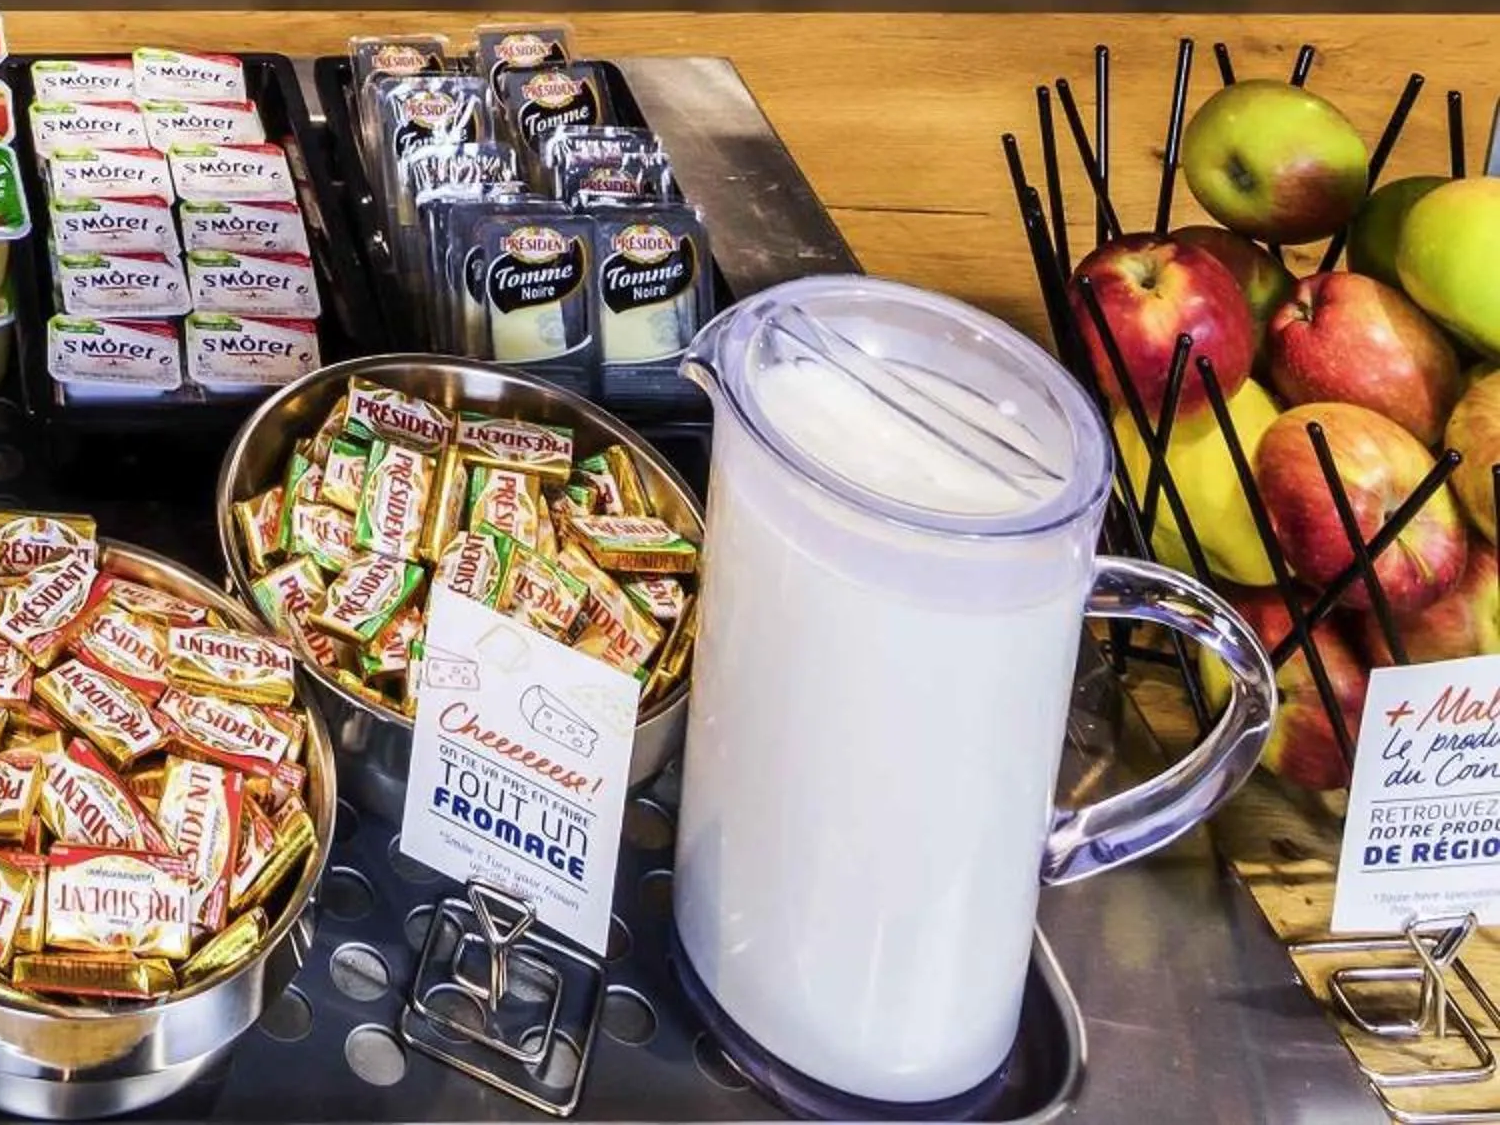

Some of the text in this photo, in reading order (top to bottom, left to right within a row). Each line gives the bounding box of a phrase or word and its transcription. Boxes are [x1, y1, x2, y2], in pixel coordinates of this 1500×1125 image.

[525, 107, 590, 135] Tomme
[502, 234, 574, 253] PRÉSIDENT
[613, 234, 681, 252] PRÉSIDENT
[495, 264, 573, 290] Tomme
[607, 261, 684, 290] Tomme
[521, 284, 555, 301] Noire
[633, 283, 667, 301] Noire
[355, 396, 453, 443] PRÉSIDENT
[465, 427, 570, 454] PRÉSIDENT
[6, 561, 88, 633] PRÉSIDENT
[175, 635, 292, 671] PRÉSIDENT
[60, 665, 151, 747] PRÉSIDENT
[165, 690, 281, 752] PRÉSIDENT
[1382, 728, 1412, 760] Le
[1384, 753, 1500, 788] du Coin
[440, 758, 588, 857] TOUT UN
[481, 764, 498, 779] VA
[502, 774, 528, 796] PAS
[550, 800, 589, 828] FAIRE
[1370, 799, 1499, 824] RETROUVEZ
[433, 786, 585, 881] FROMAGE
[1368, 824, 1433, 840] NOTRE
[1364, 836, 1500, 866] DE RÉGIO
[57, 884, 186, 924] PRÉSIDENT
